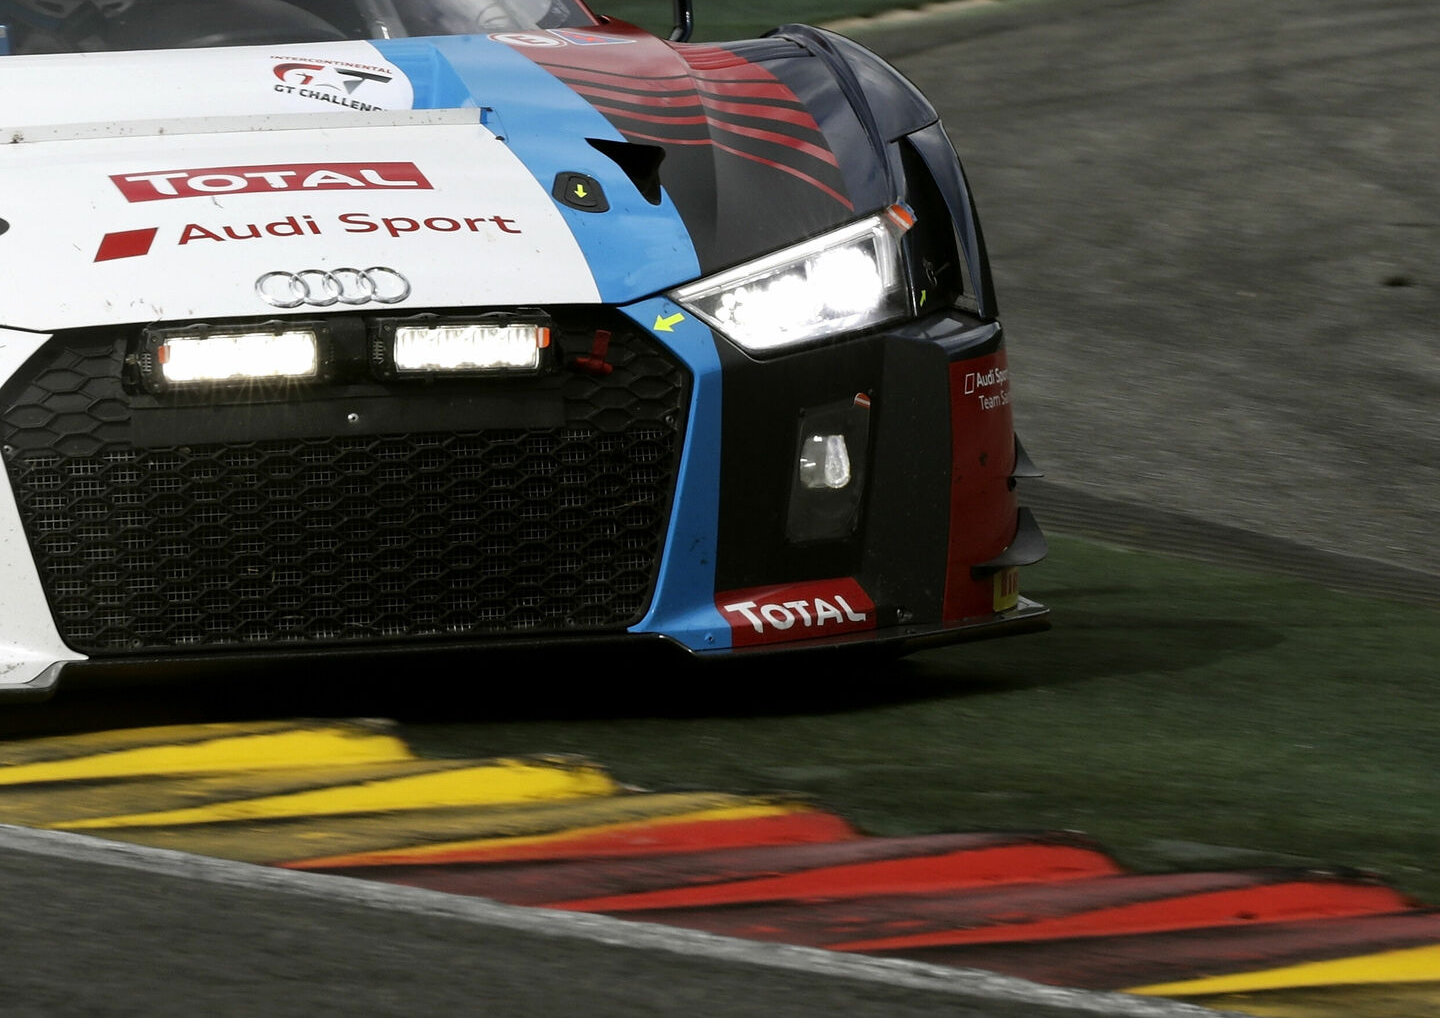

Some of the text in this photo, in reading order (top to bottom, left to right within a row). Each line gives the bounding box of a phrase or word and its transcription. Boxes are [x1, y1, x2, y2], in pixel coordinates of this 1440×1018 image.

[270, 55, 393, 74] INTERCONTINENTAL
[274, 84, 388, 111] GT CHALLEN
[125, 169, 419, 196] TOTAL
[177, 212, 523, 246] Audi Sport
[976, 369, 995, 387] Audi
[978, 394, 1001, 410] Team
[723, 595, 867, 634] TOTAL
